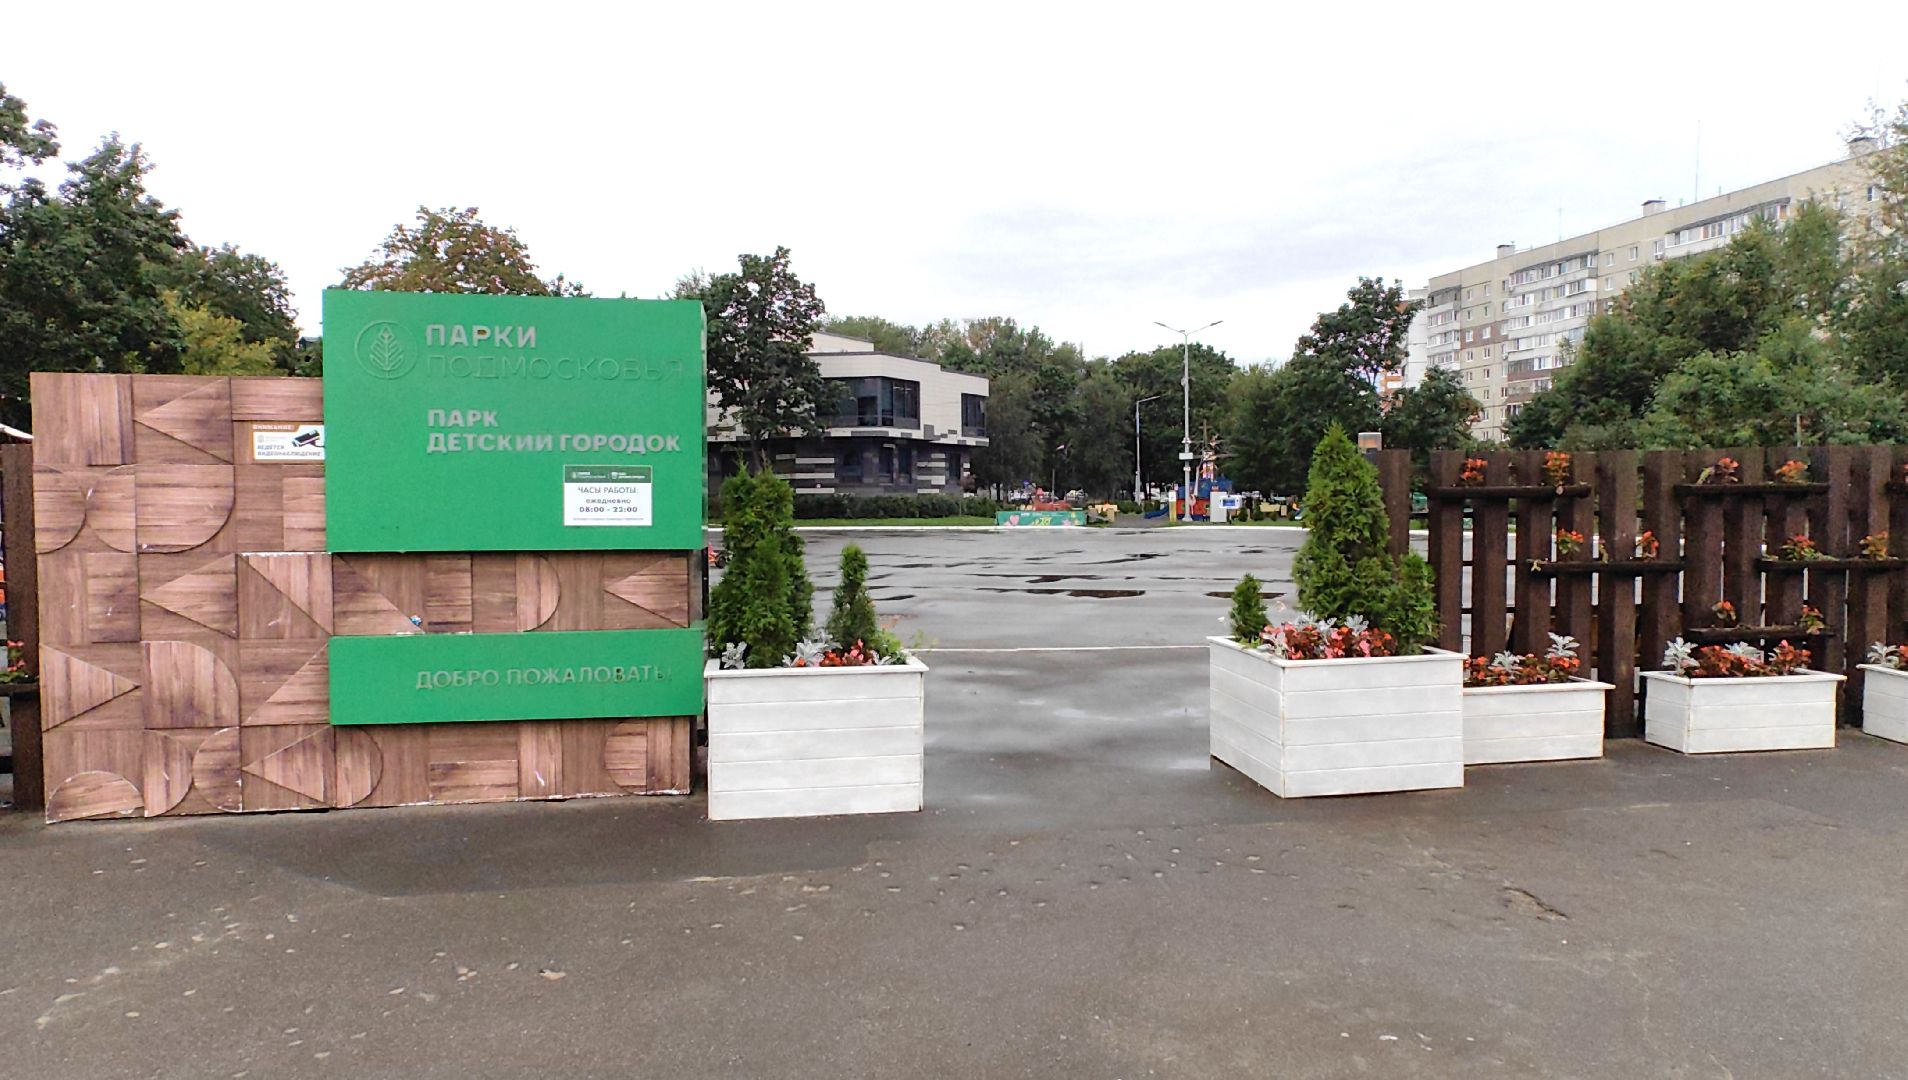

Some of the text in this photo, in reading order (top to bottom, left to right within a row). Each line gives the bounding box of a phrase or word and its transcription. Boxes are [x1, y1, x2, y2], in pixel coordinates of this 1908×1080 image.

[426, 323, 537, 349] ПАРКИ
[427, 354, 682, 381] ПОДМОСКОВЬЯ
[427, 408, 499, 428] ПАРК
[560, 434, 681, 455] ГОРОДОК
[577, 486, 601, 494] ЧАСЫ
[415, 670, 499, 690] ДОБРО
